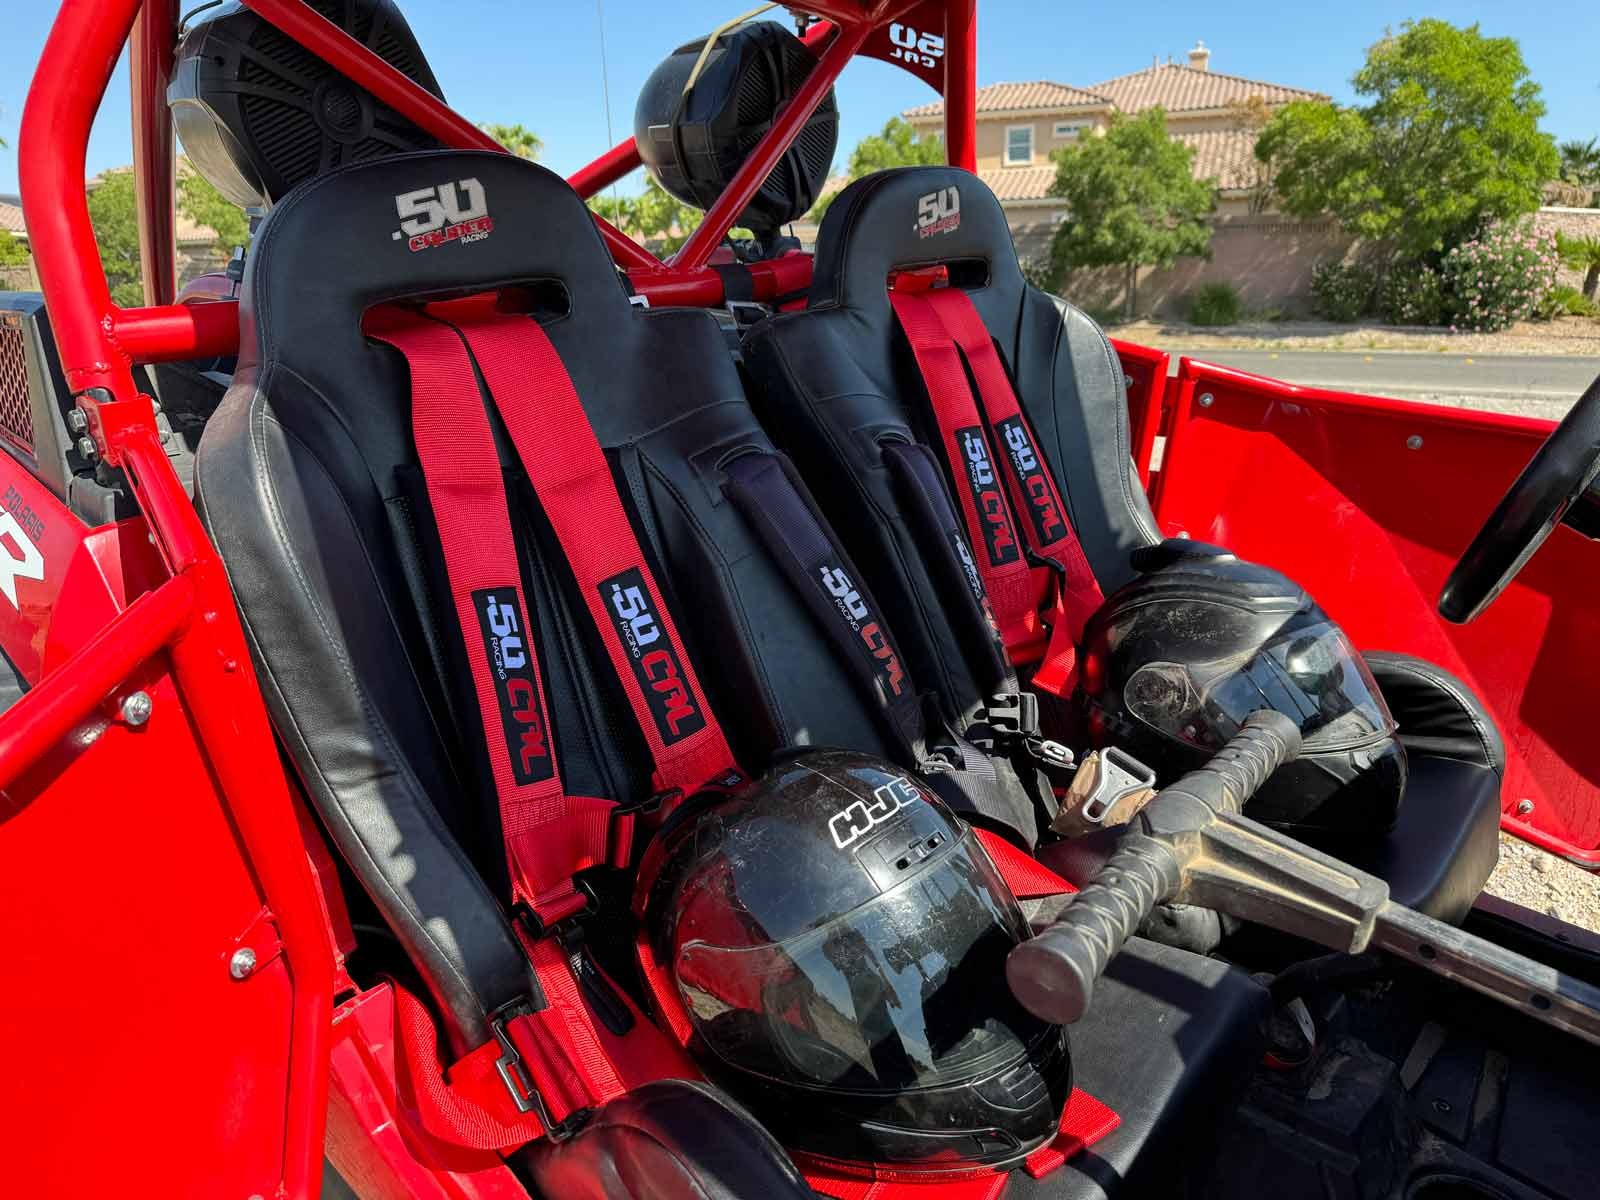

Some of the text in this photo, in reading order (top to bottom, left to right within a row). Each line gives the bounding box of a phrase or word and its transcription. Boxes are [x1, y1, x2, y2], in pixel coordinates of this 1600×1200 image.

[3, 484, 45, 542] POLARIS
[834, 598, 860, 632] RACING
[490, 636, 507, 680] RACING
[620, 620, 641, 658] RACING
[828, 777, 921, 849] HJC
